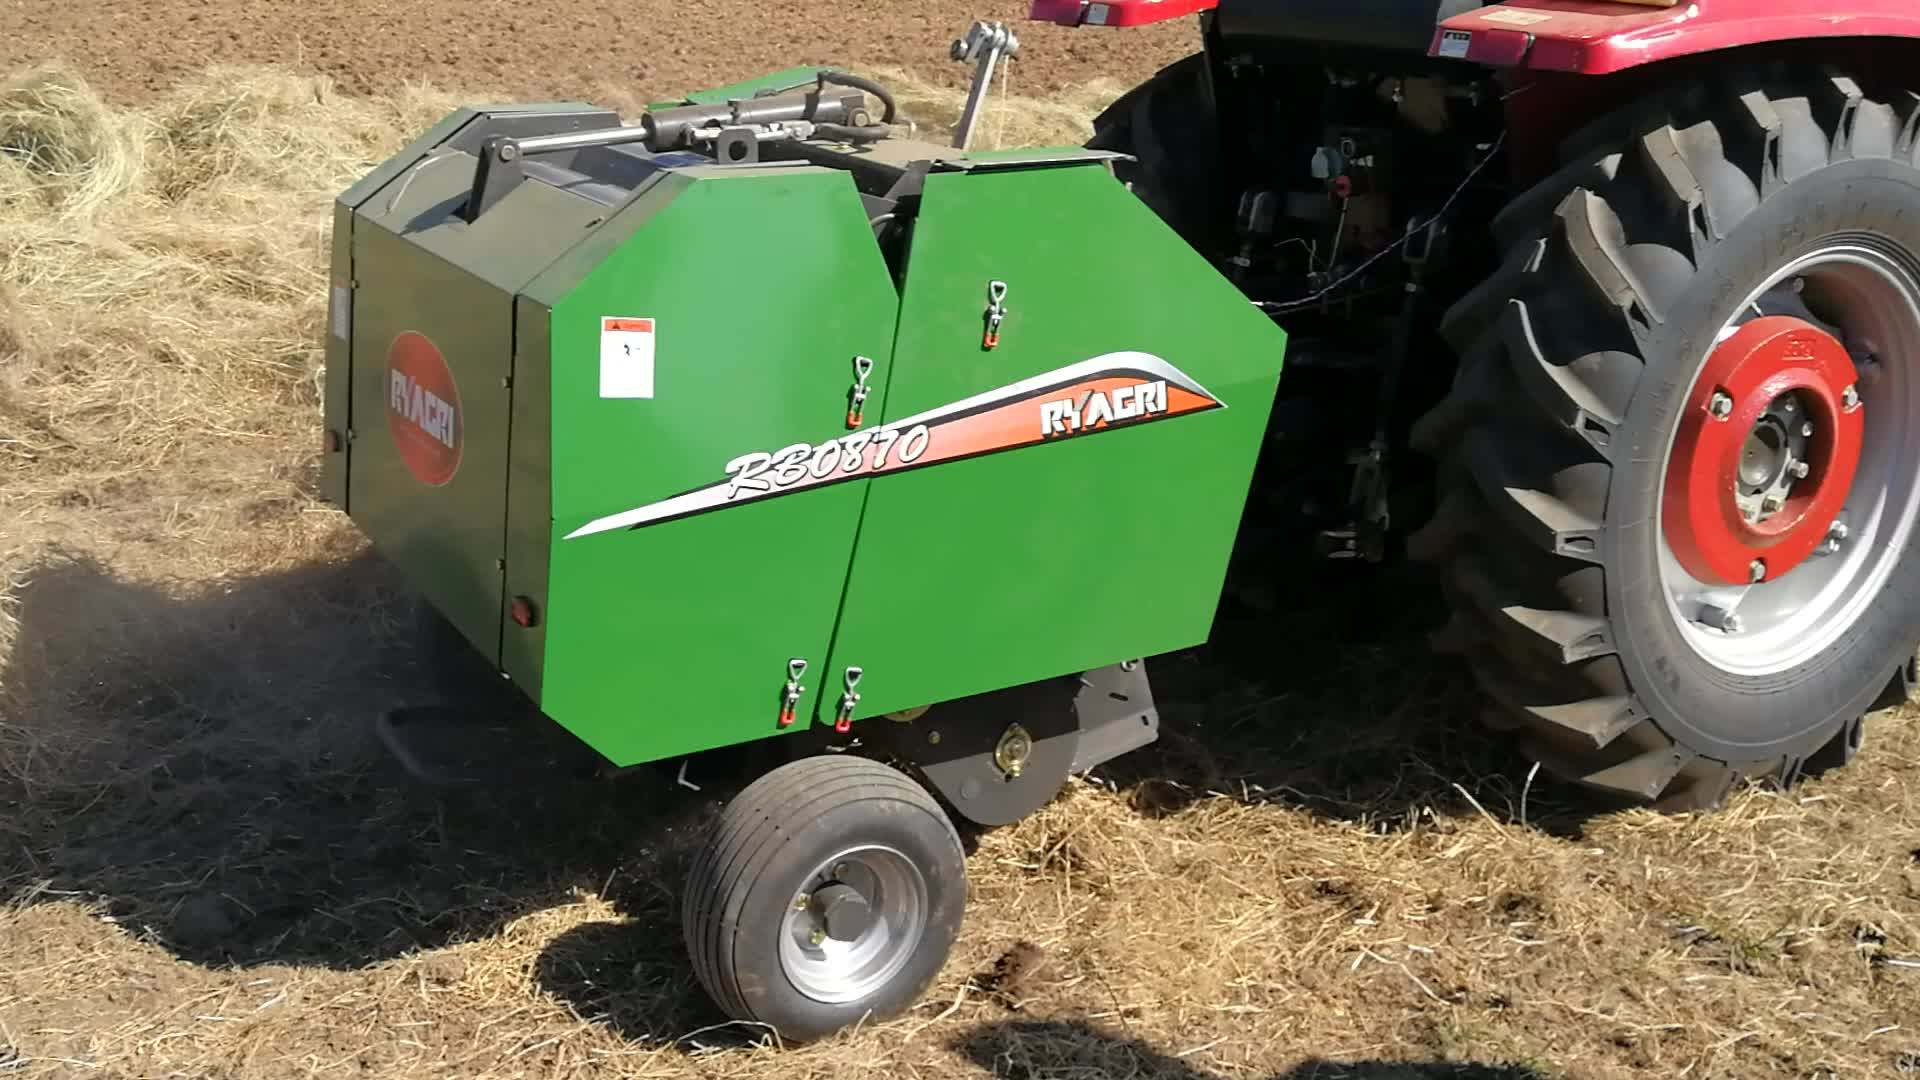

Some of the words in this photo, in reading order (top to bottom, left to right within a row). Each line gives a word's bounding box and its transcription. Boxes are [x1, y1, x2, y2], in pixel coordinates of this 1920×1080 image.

[391, 368, 455, 449] RYAGRI
[1040, 380, 1168, 436] RYAGRI
[724, 424, 931, 499] RB0870
